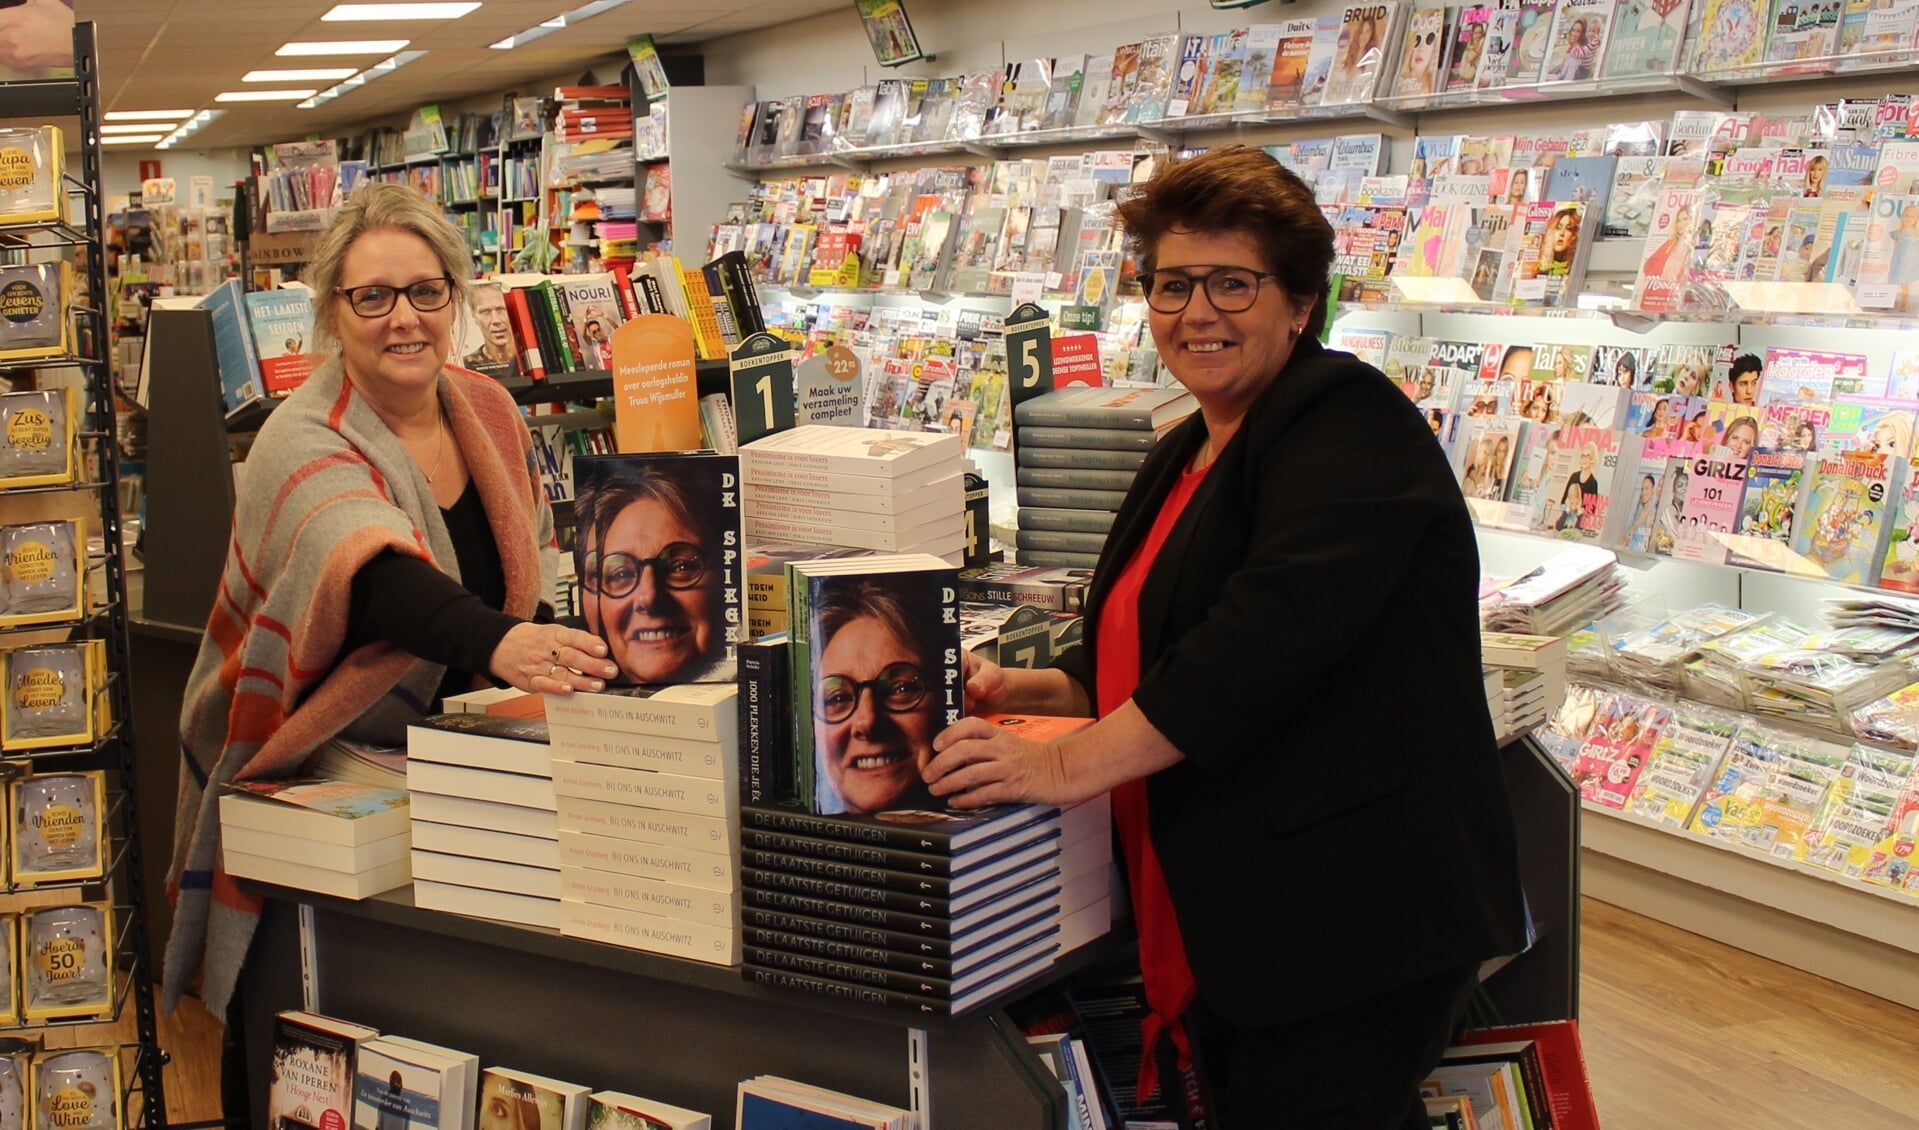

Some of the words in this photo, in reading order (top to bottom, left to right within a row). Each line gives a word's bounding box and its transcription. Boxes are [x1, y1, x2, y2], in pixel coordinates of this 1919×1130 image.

[1344, 6, 1386, 23] BRUID
[1411, 12, 1442, 31] Oude
[1287, 22, 1311, 32] Duits
[1338, 140, 1374, 154] Columbus
[0, 152, 31, 169] apa
[0, 171, 34, 186] even!
[569, 287, 612, 302] NOURI
[254, 306, 271, 318] HET
[274, 302, 310, 316] LAATSTE
[1063, 311, 1081, 323] Onze
[1082, 312, 1095, 326] tip!
[268, 320, 304, 336] SEIZOEN
[1011, 321, 1044, 333] BOEKENTOPPER
[1341, 335, 1384, 350] MINDFULNESS
[620, 360, 668, 376] Meeslepende
[668, 358, 691, 370] roman
[740, 353, 784, 368] BOEKENTOPPER
[1022, 338, 1040, 388] 5
[1534, 344, 1587, 374] Tales
[1052, 366, 1068, 376] DEENSE
[1070, 362, 1098, 373] TOPTHRILLER
[624, 381, 640, 392] over
[642, 373, 688, 388] oorlogsheldin
[810, 384, 834, 398] Maak
[838, 385, 852, 394] uw
[628, 396, 648, 407] Truus
[650, 390, 686, 404] Wijsmuller
[756, 375, 774, 430] 1
[802, 394, 858, 410] verzameling
[14, 411, 46, 427] Zus
[810, 406, 852, 420] compleet
[1768, 406, 1830, 426] MEDEN
[1604, 455, 1618, 468] 189
[1694, 459, 1746, 481] GIRLZ
[1820, 458, 1856, 476] Donald
[1858, 462, 1888, 480] Duck
[1704, 488, 1722, 500] 101
[756, 502, 790, 511] Pessimisme
[814, 507, 831, 516] losers
[755, 521, 791, 530] Pessimisme
[814, 526, 831, 536] losers
[964, 510, 978, 557] 4
[4, 548, 58, 567] Vrienden
[749, 584, 774, 592] TREIN
[748, 594, 768, 602] HEID
[987, 590, 1012, 600] STILLE
[1013, 594, 1054, 604] SCHREEUW
[1006, 624, 1044, 642] BOEKENTOPPER
[1016, 645, 1036, 669] 7
[749, 680, 758, 702] 1000
[944, 648, 960, 726] SPIE
[20, 694, 62, 708] Leven!
[598, 708, 607, 718] BIJ
[609, 709, 624, 719] ONS
[626, 712, 633, 720] IN
[636, 712, 676, 725] AUSCHWITZ
[750, 704, 760, 754] PLEKKEN
[604, 744, 613, 753] BIJ
[615, 745, 630, 755] ONS
[633, 747, 639, 756] IN
[642, 748, 682, 761] AUSCHWITZ
[751, 756, 760, 774] DIE
[606, 781, 615, 791] BIJ
[618, 783, 632, 792] ONS
[635, 784, 641, 794] IN
[645, 786, 685, 800] AUSCHWITZ
[752, 776, 760, 788] JE
[752, 790, 762, 802] ÉC
[32, 812, 86, 829] Vrienden
[610, 817, 619, 826] BIJ
[621, 818, 636, 828] ONS
[639, 820, 646, 830] IN
[648, 822, 688, 836] AUSCHWITZ
[755, 813, 771, 827] DE
[773, 816, 822, 833] LAATSTE
[825, 823, 887, 842] GETUIGEN
[755, 834, 771, 847] DE
[773, 837, 822, 854] LAATSTE
[825, 845, 887, 863] GETUIGEN
[612, 852, 621, 862] BIJ
[624, 853, 638, 863] ONS
[641, 856, 648, 865] IN
[651, 857, 691, 872] AUSCHWITZ
[755, 853, 771, 866] DE
[773, 856, 822, 873] LAATSTE
[825, 864, 887, 883] GETUIGEN
[755, 872, 771, 885] DE
[773, 875, 822, 892] LAATSTE
[825, 883, 887, 902] GETUIGEN
[756, 891, 772, 904] DE
[774, 894, 823, 911] LAATSTE
[826, 904, 888, 922] GETUIGEN
[756, 912, 771, 926] DE
[774, 916, 823, 933] LAATSTE
[826, 926, 887, 944] GETUIGEN
[41, 941, 82, 956] Hoera
[50, 953, 75, 970] 50
[290, 1056, 328, 1076] ROXANE
[280, 1066, 298, 1081] VAN
[300, 1074, 337, 1093] IPEREN
[52, 1094, 90, 1112] Love
[50, 1112, 90, 1128] Wine
